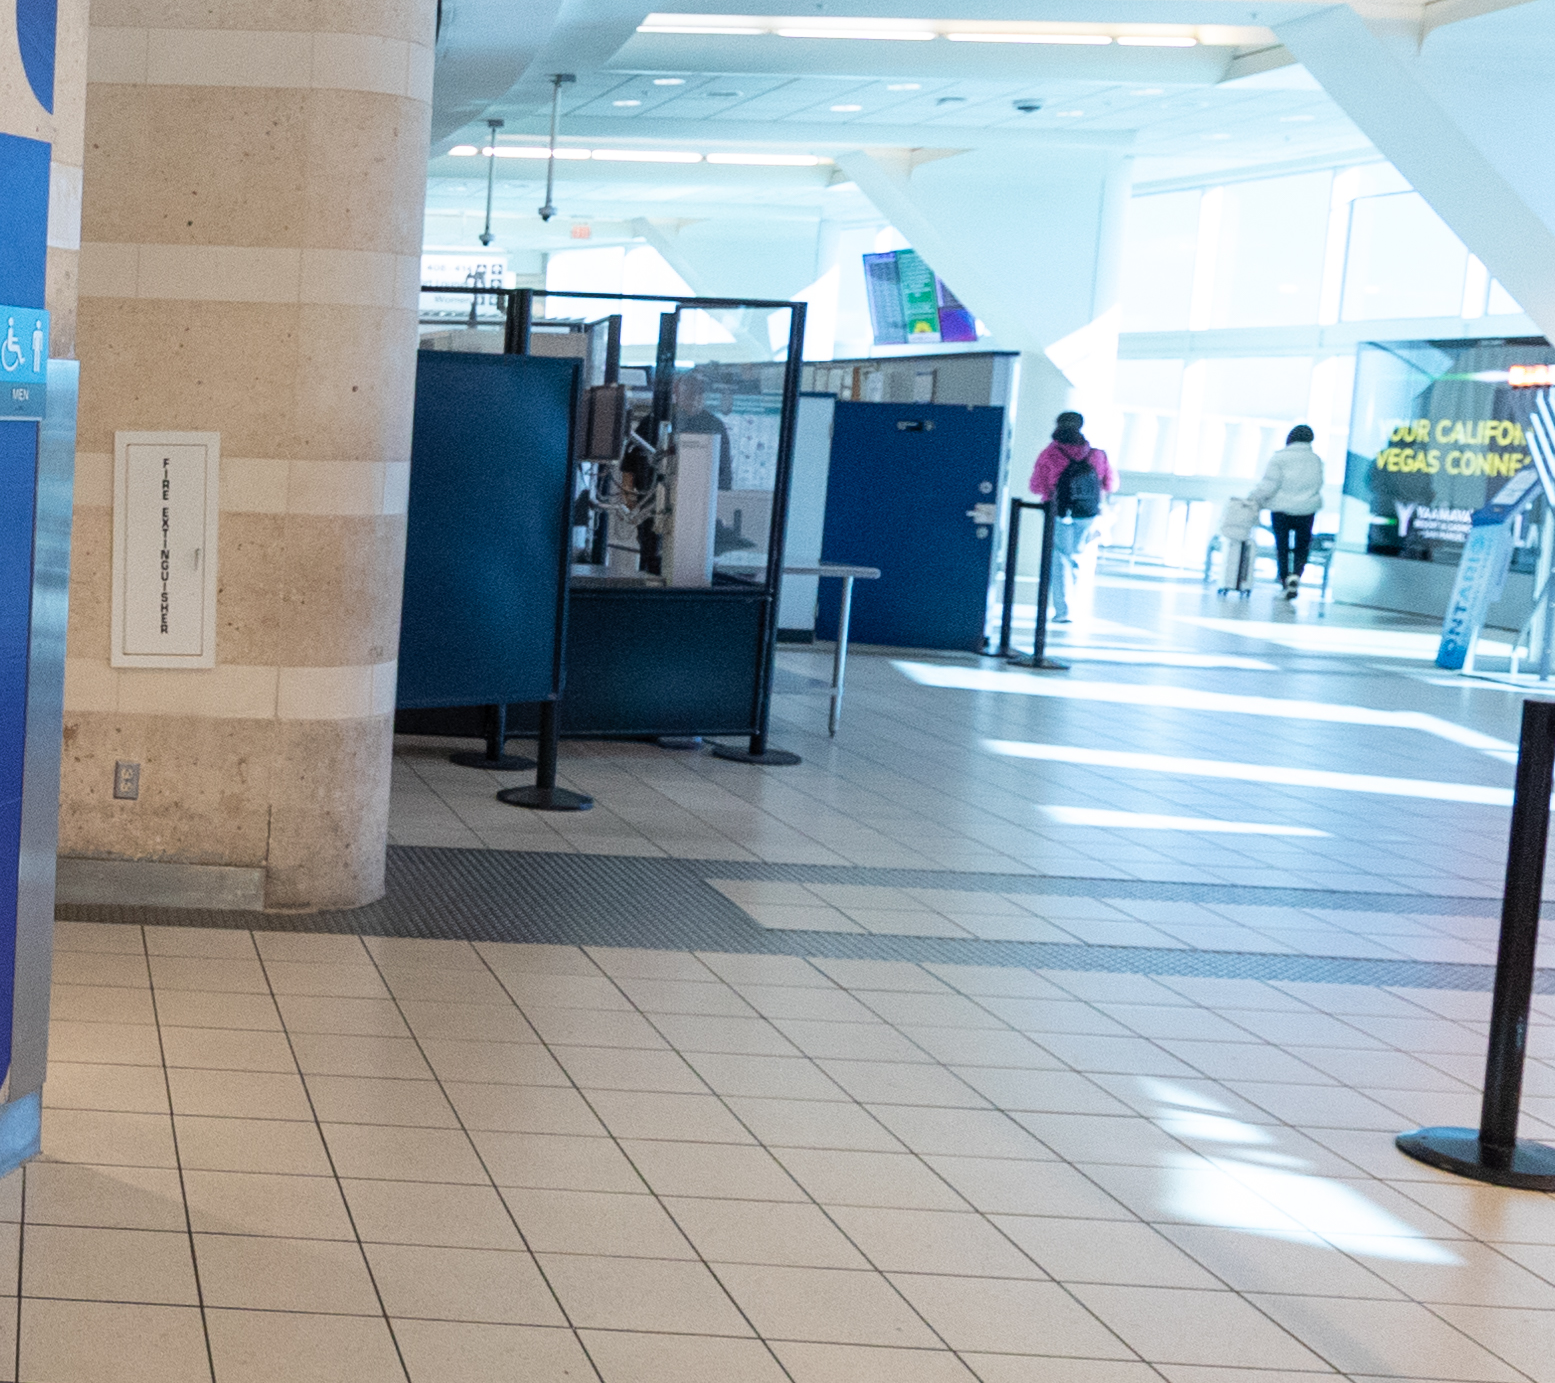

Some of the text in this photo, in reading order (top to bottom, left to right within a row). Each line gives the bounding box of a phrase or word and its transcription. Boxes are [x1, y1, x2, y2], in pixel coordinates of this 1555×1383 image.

[12, 388, 29, 400] MEN
[1376, 448, 1440, 474] VEGAS
[160, 458, 170, 634] FIRE EXTINGUISHER
